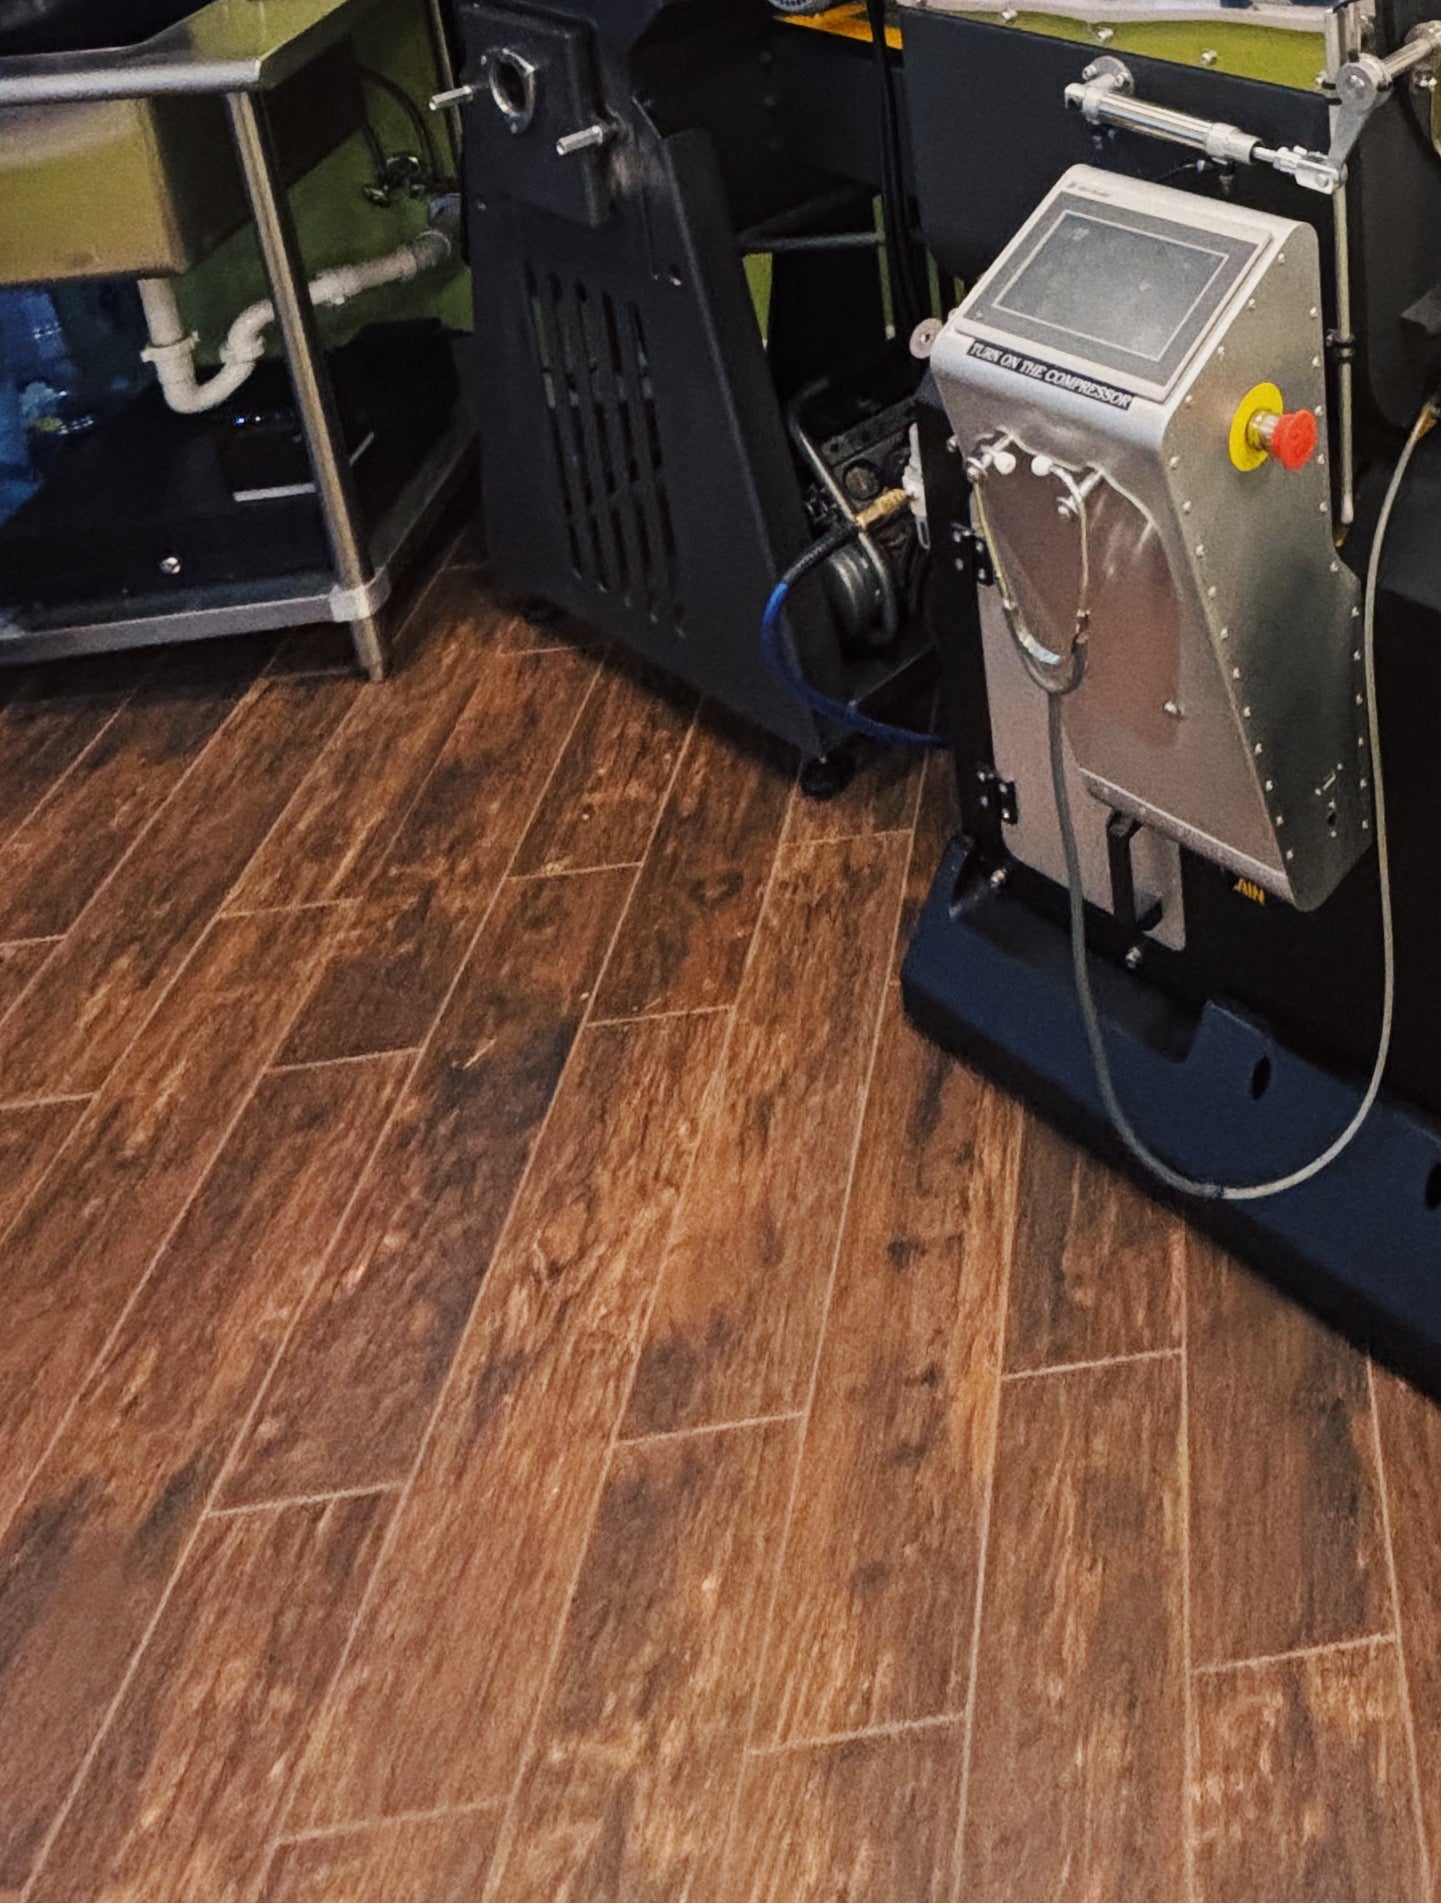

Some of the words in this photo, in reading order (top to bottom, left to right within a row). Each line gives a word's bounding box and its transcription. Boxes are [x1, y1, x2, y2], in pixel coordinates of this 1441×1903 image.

[970, 342, 1002, 362] TURN
[1000, 353, 1021, 369] ON
[1020, 359, 1047, 379] THE
[1044, 369, 1133, 408] COMPRESSOR
